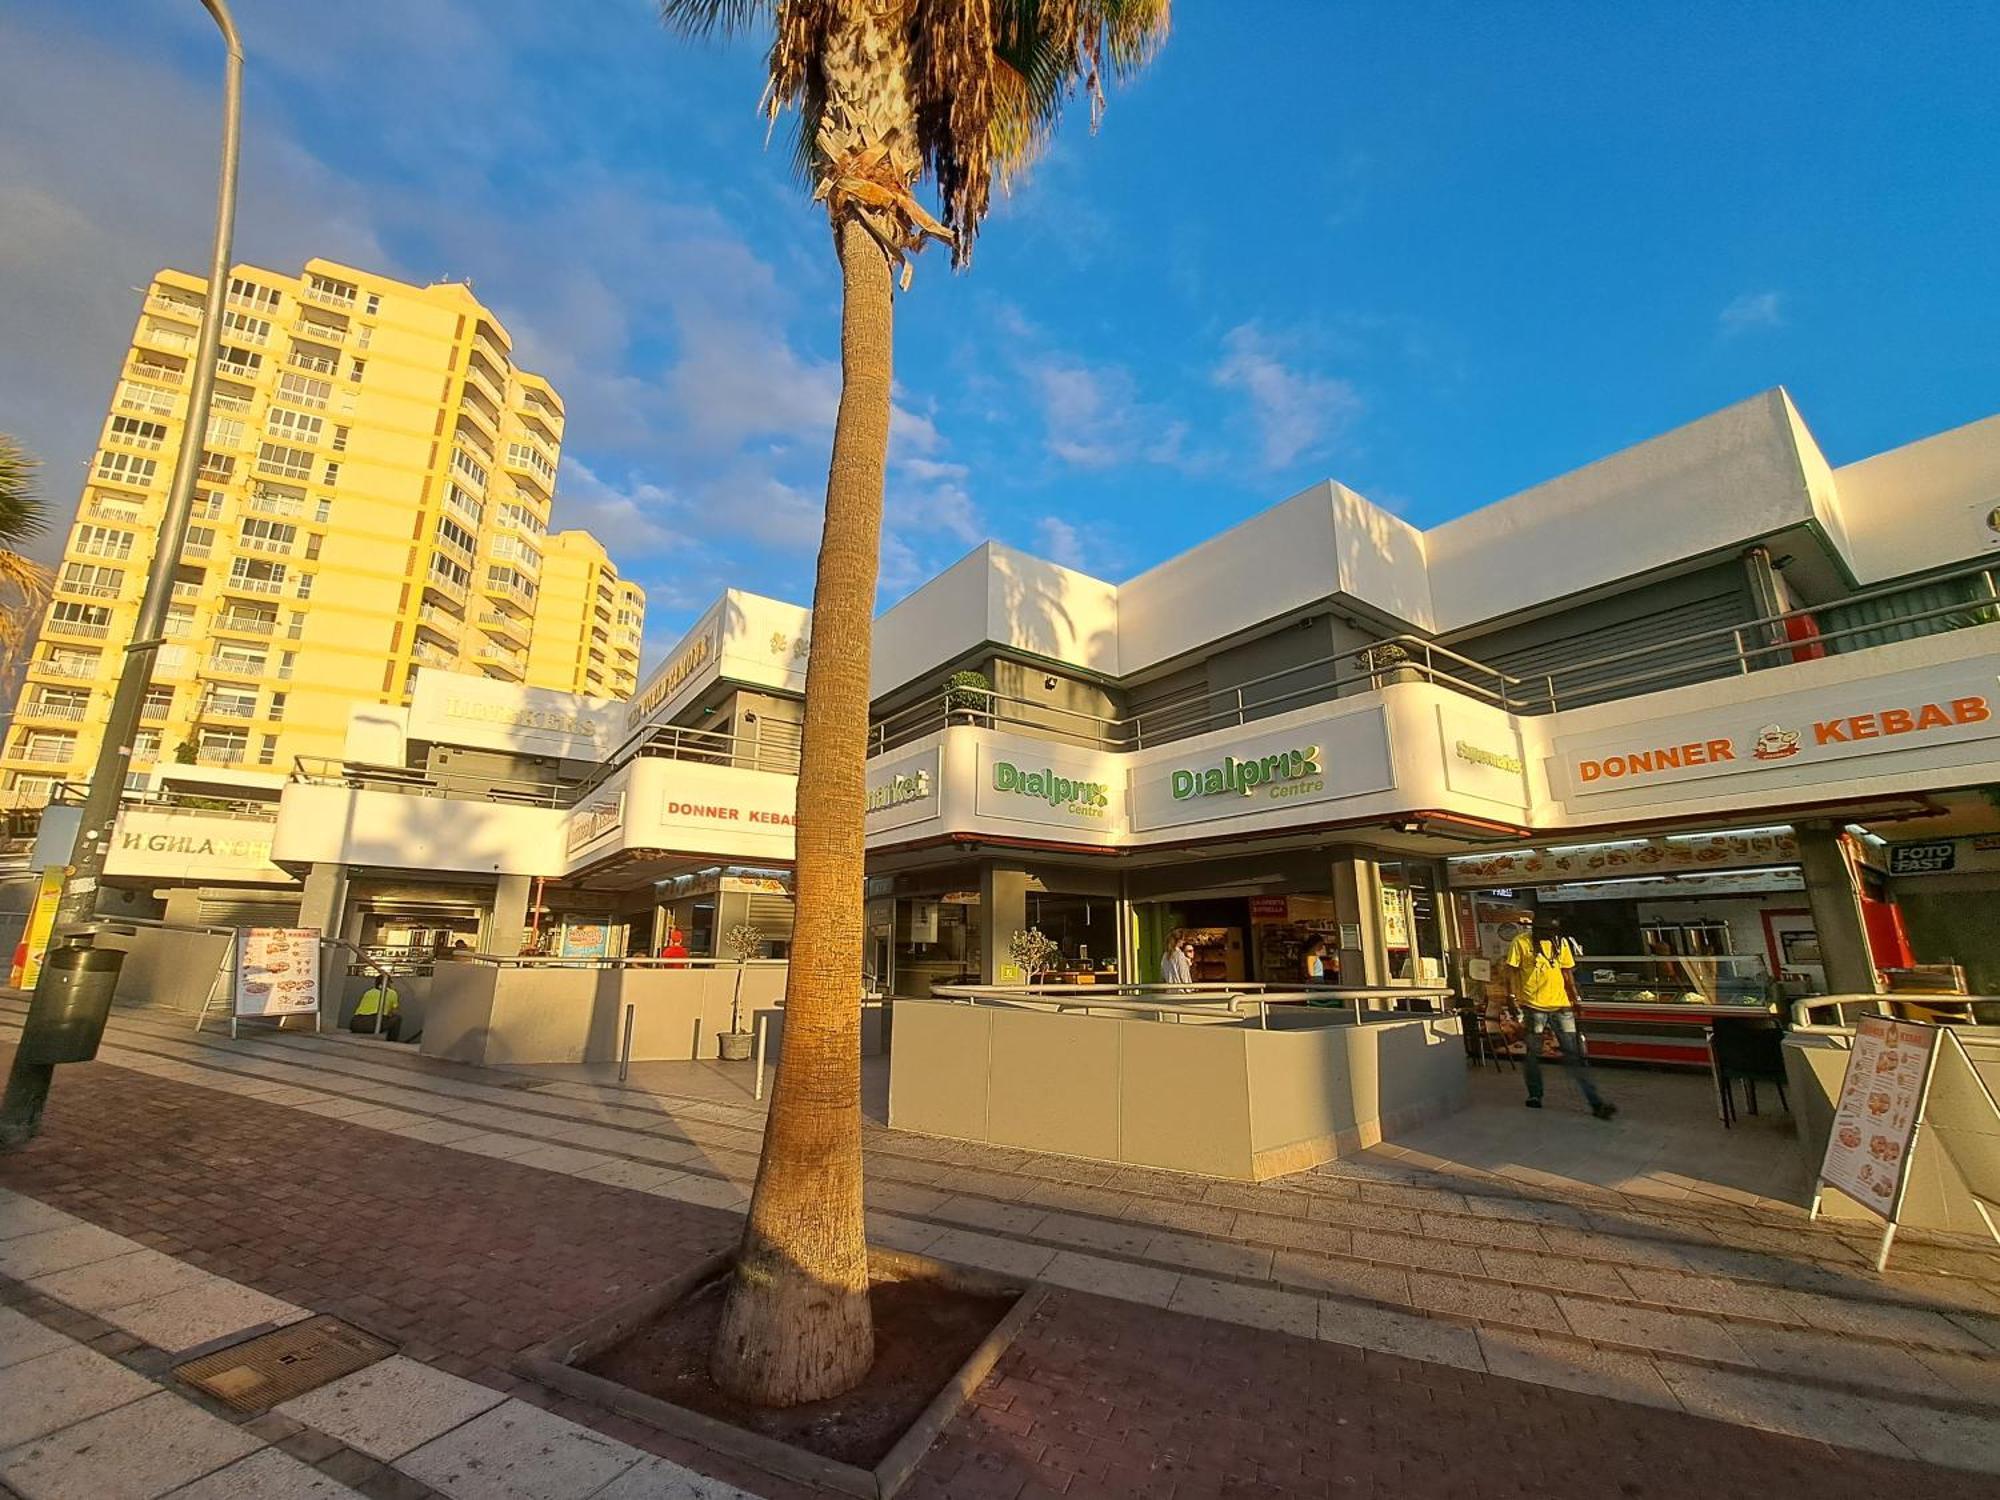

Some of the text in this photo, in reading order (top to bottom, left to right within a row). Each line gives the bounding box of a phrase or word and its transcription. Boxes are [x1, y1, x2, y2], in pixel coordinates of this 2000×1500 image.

[1579, 695, 1991, 783] DONNER KEBAB
[864, 769, 930, 811] market
[1269, 779, 1324, 799] Centre
[668, 802, 739, 821] DONNER
[1068, 804, 1104, 818] Centre
[1897, 845, 1952, 860] FOTO
[1896, 857, 1946, 871] FAST
